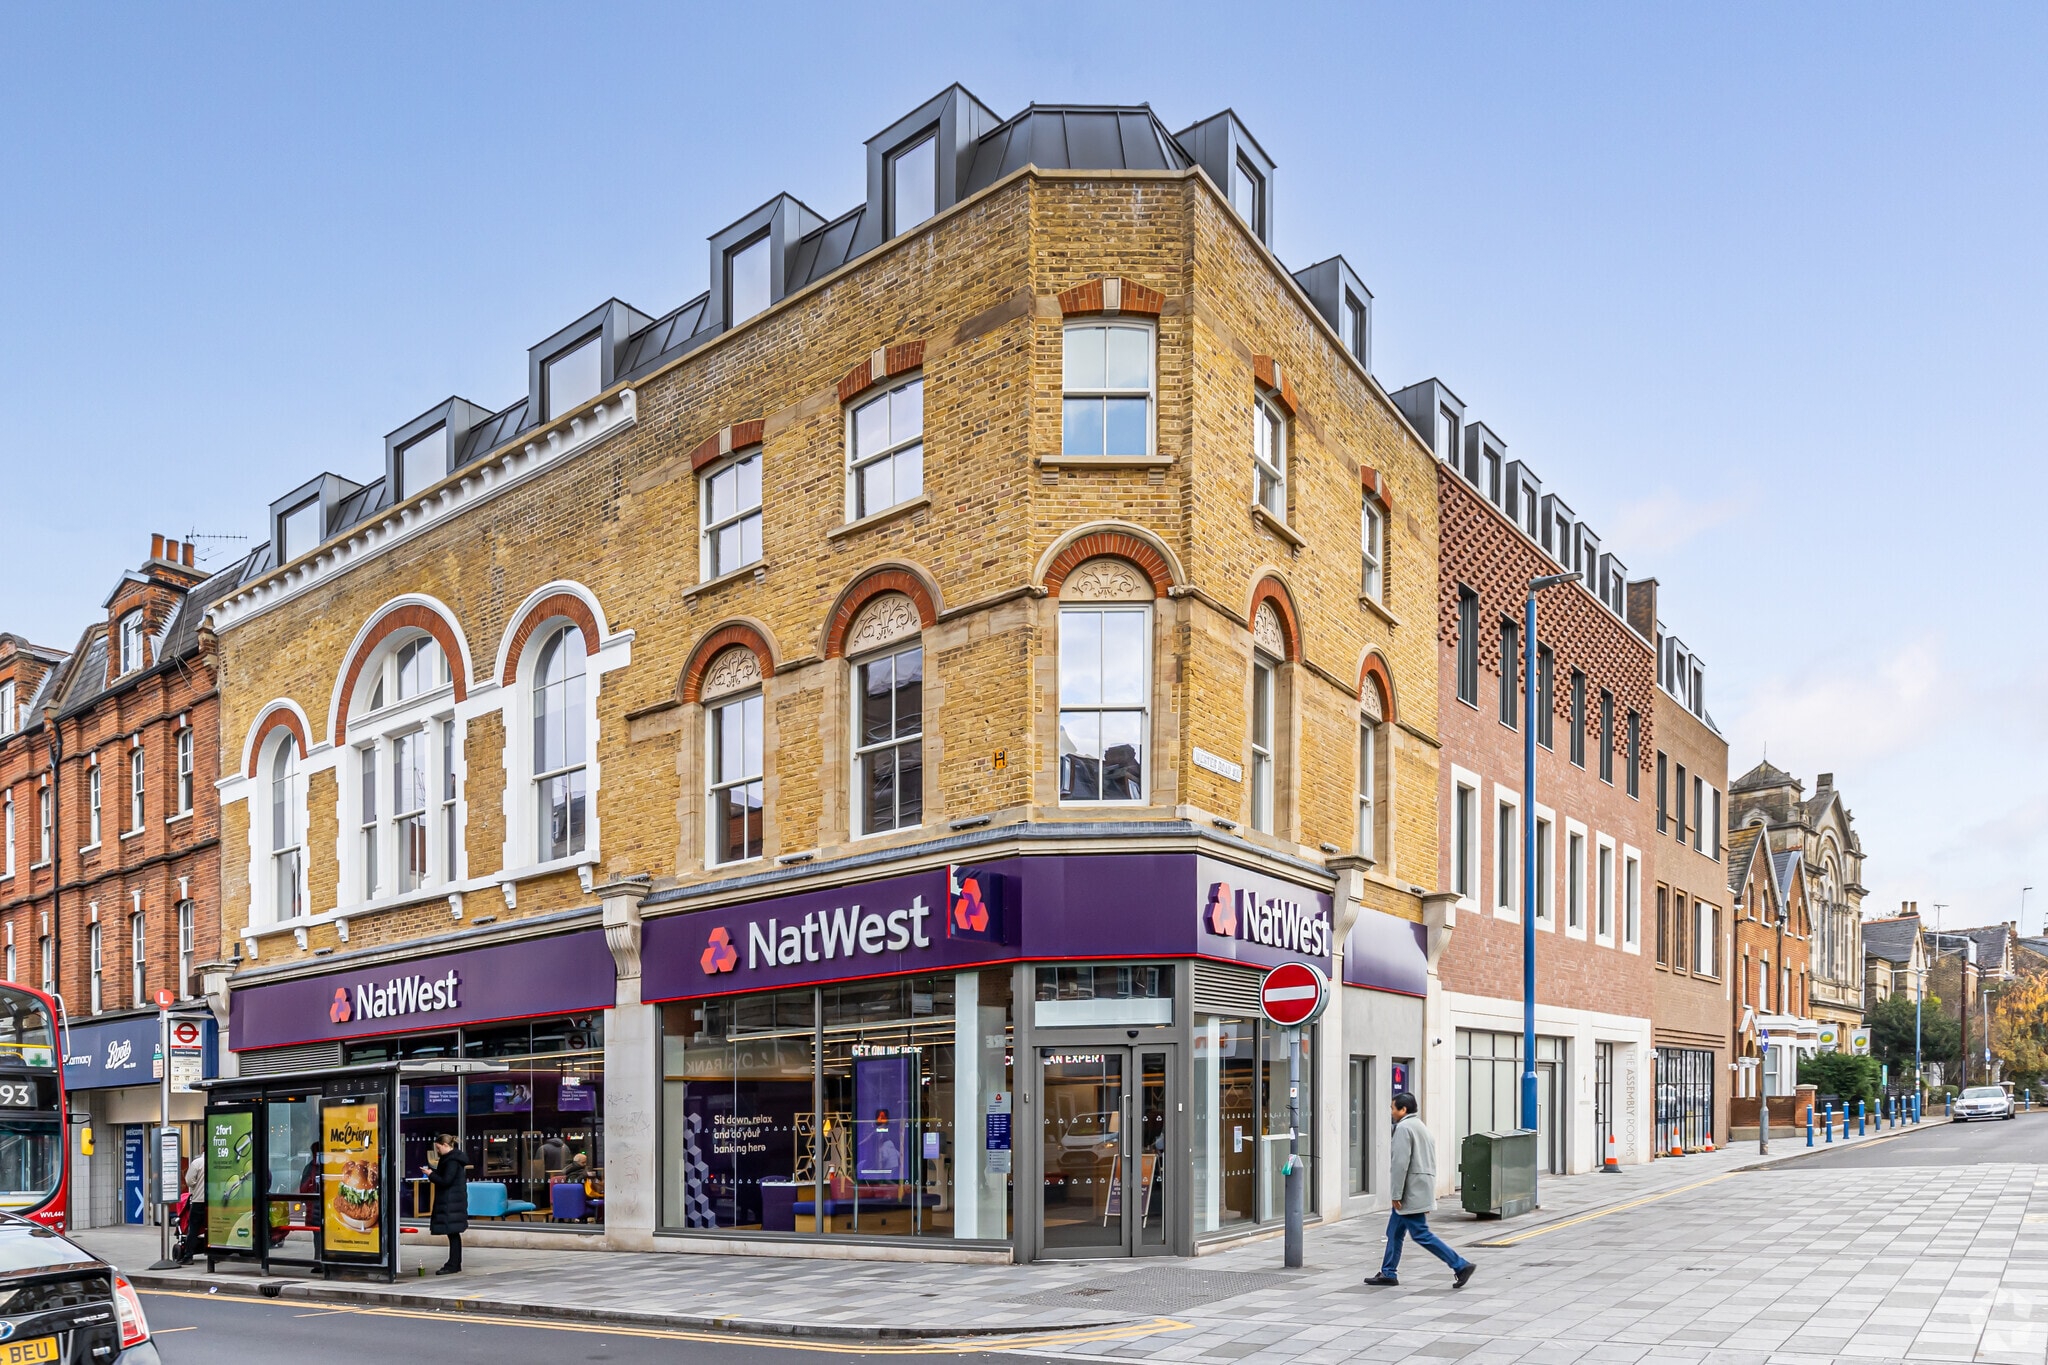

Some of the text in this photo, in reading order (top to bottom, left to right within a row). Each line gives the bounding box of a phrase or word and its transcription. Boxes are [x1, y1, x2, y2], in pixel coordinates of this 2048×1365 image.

[1243, 888, 1329, 957] NatWest
[749, 894, 930, 969] NatWest
[160, 992, 168, 1004] L
[356, 969, 457, 1020] NatWest
[105, 1039, 132, 1070] Boots
[852, 1044, 871, 1056] GET
[871, 1045, 900, 1056] ONLINE
[62, 1054, 92, 1067] Parmacy
[1065, 1054, 1104, 1064] EXPERT
[1626, 1049, 1635, 1157] THE ASSEMBLY ROOMS
[714, 1114, 726, 1125] Sit
[752, 1114, 773, 1124] relax
[126, 1128, 143, 1136] welcom
[330, 1121, 373, 1149] McCrispy
[714, 1130, 761, 1141] and do your
[213, 1136, 227, 1147] from
[217, 1147, 229, 1158] £69
[714, 1142, 767, 1155] banking here
[9, 1341, 48, 1364] BEU
